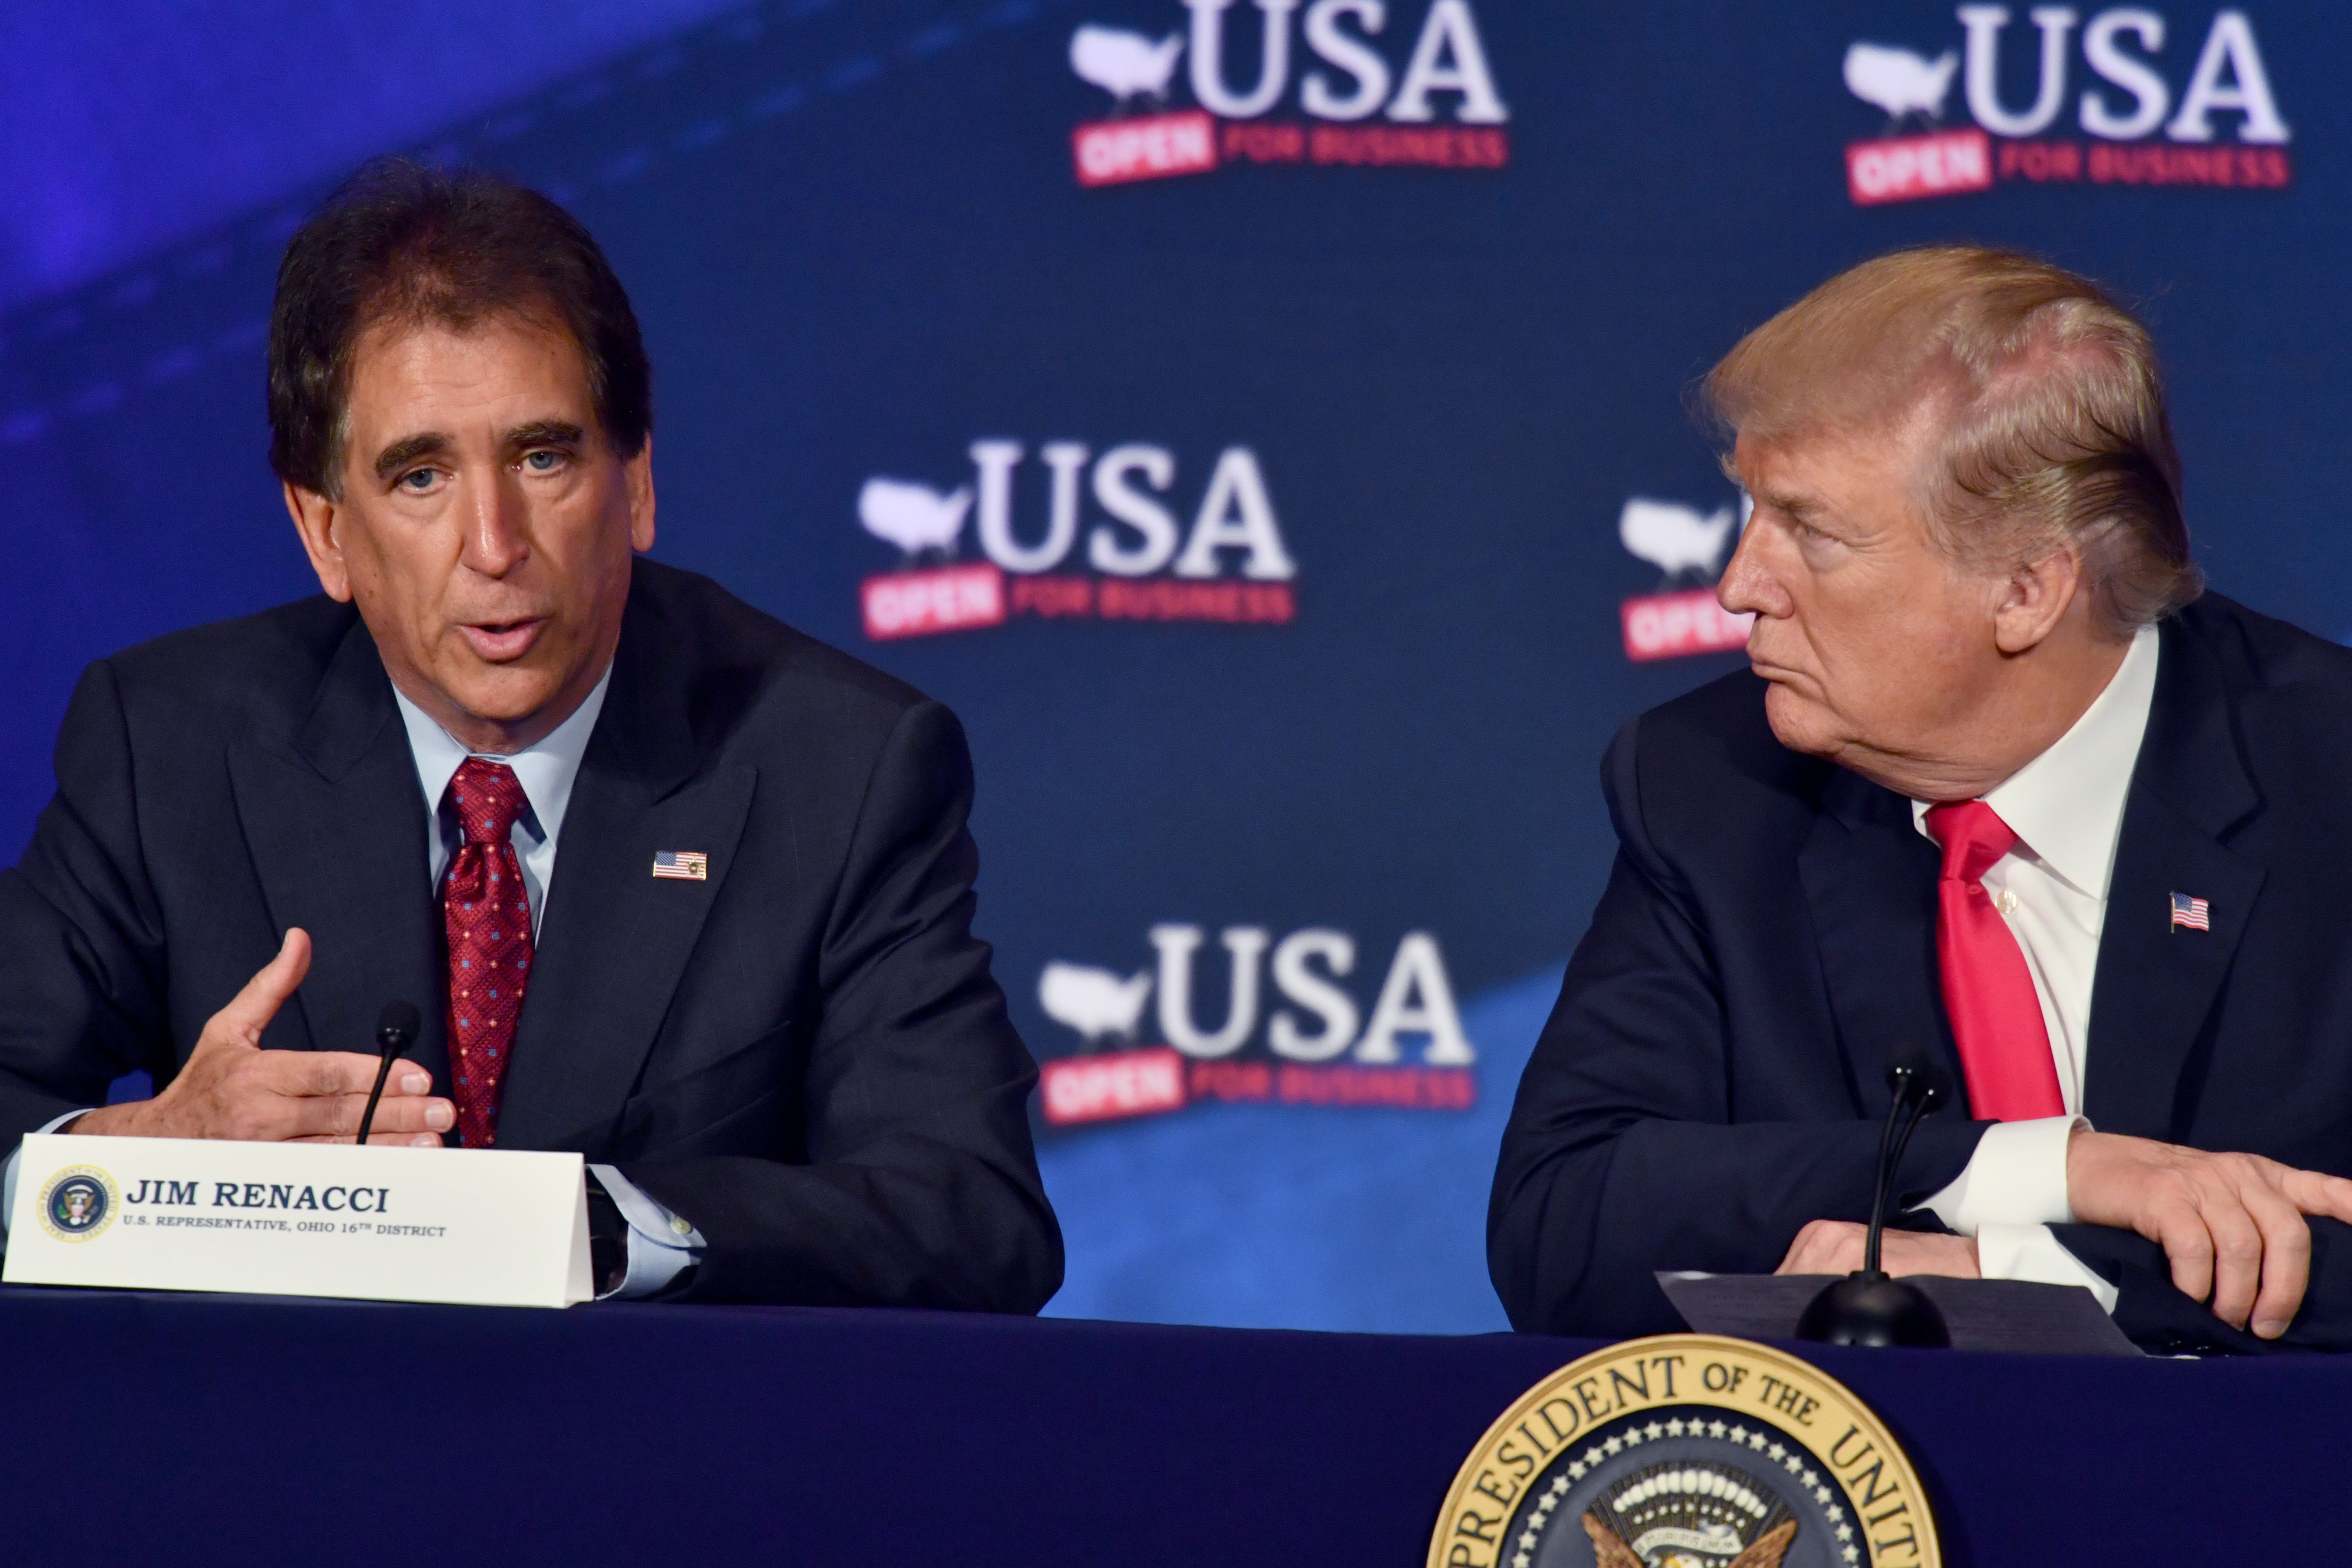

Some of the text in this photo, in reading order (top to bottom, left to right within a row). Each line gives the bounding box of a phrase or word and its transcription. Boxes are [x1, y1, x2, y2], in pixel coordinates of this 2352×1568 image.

[1184, 0, 1507, 122] USA
[1958, 5, 2289, 144] USA
[1079, 124, 1508, 177] OPEN FOR BUSINESS
[1852, 140, 2289, 197] OPEN FOR BUSINESS
[970, 441, 1294, 580] USA
[867, 575, 1295, 630] OPEN FOR BUSINESS
[1151, 925, 1476, 1064] USA
[1048, 1059, 1473, 1116] OPEN FOR BUSINESS
[127, 1180, 389, 1213] JIM RENACCI
[123, 1215, 149, 1226] U.S.
[155, 1216, 291, 1233] REPRESENTATIVE,
[297, 1221, 335, 1233] OHIO
[376, 1224, 446, 1237] DISTRICT
[1448, 1355, 1920, 1568] PRESIDENT OF THE UNIT
